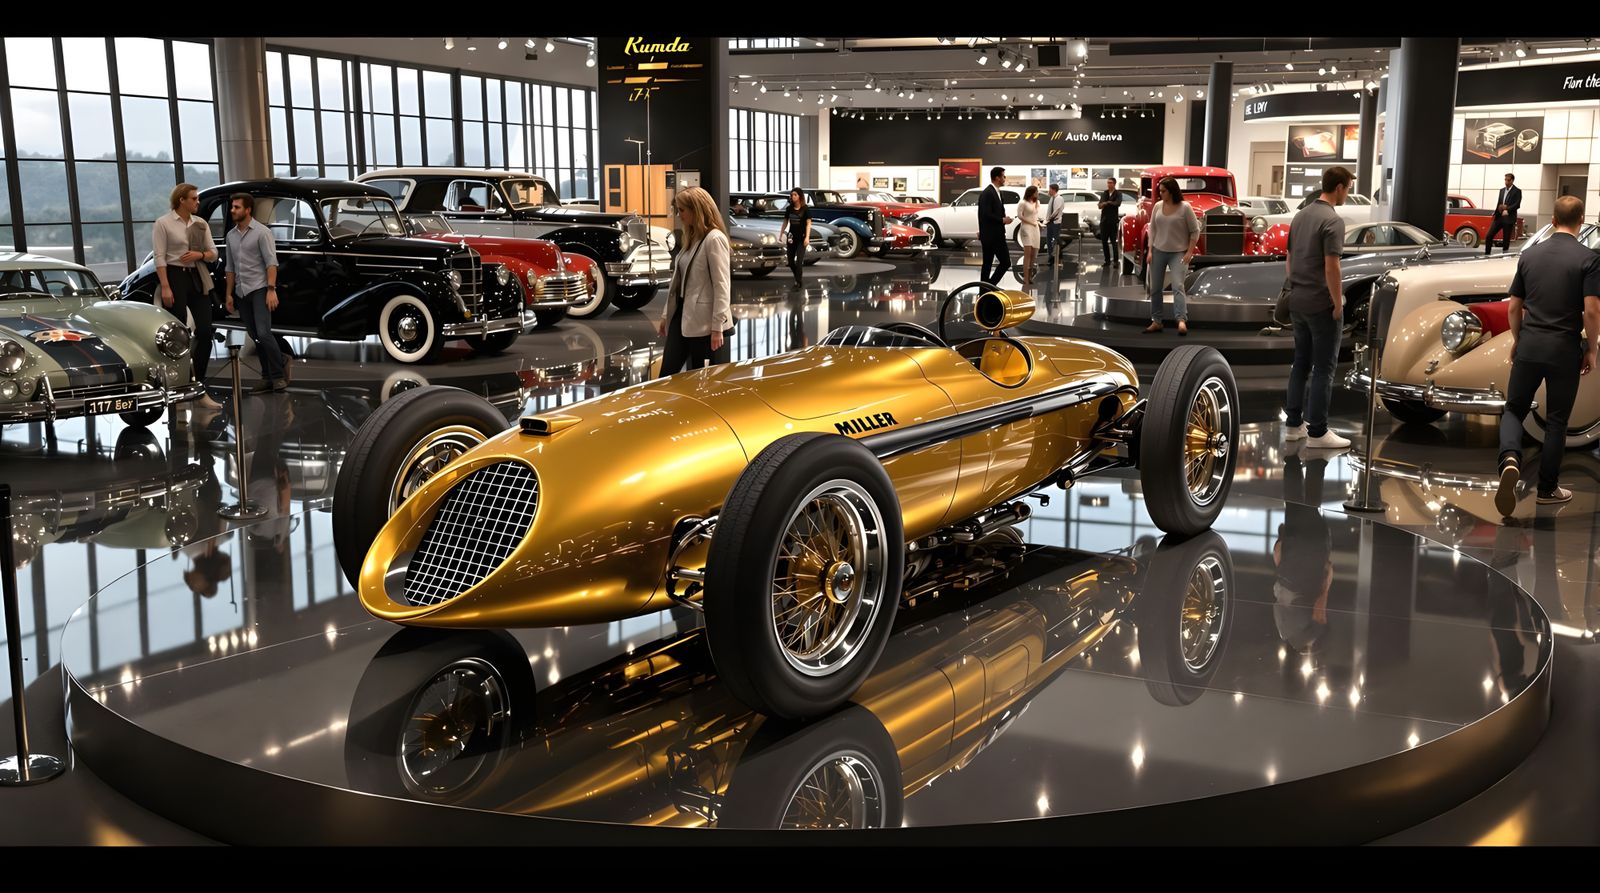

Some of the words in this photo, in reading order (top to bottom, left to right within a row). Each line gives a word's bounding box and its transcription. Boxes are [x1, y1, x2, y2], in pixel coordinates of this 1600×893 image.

[624, 36, 690, 55] Kumda
[1064, 131, 1089, 142] Auto
[1091, 131, 1123, 141] Menva
[834, 412, 899, 436] MILLER
